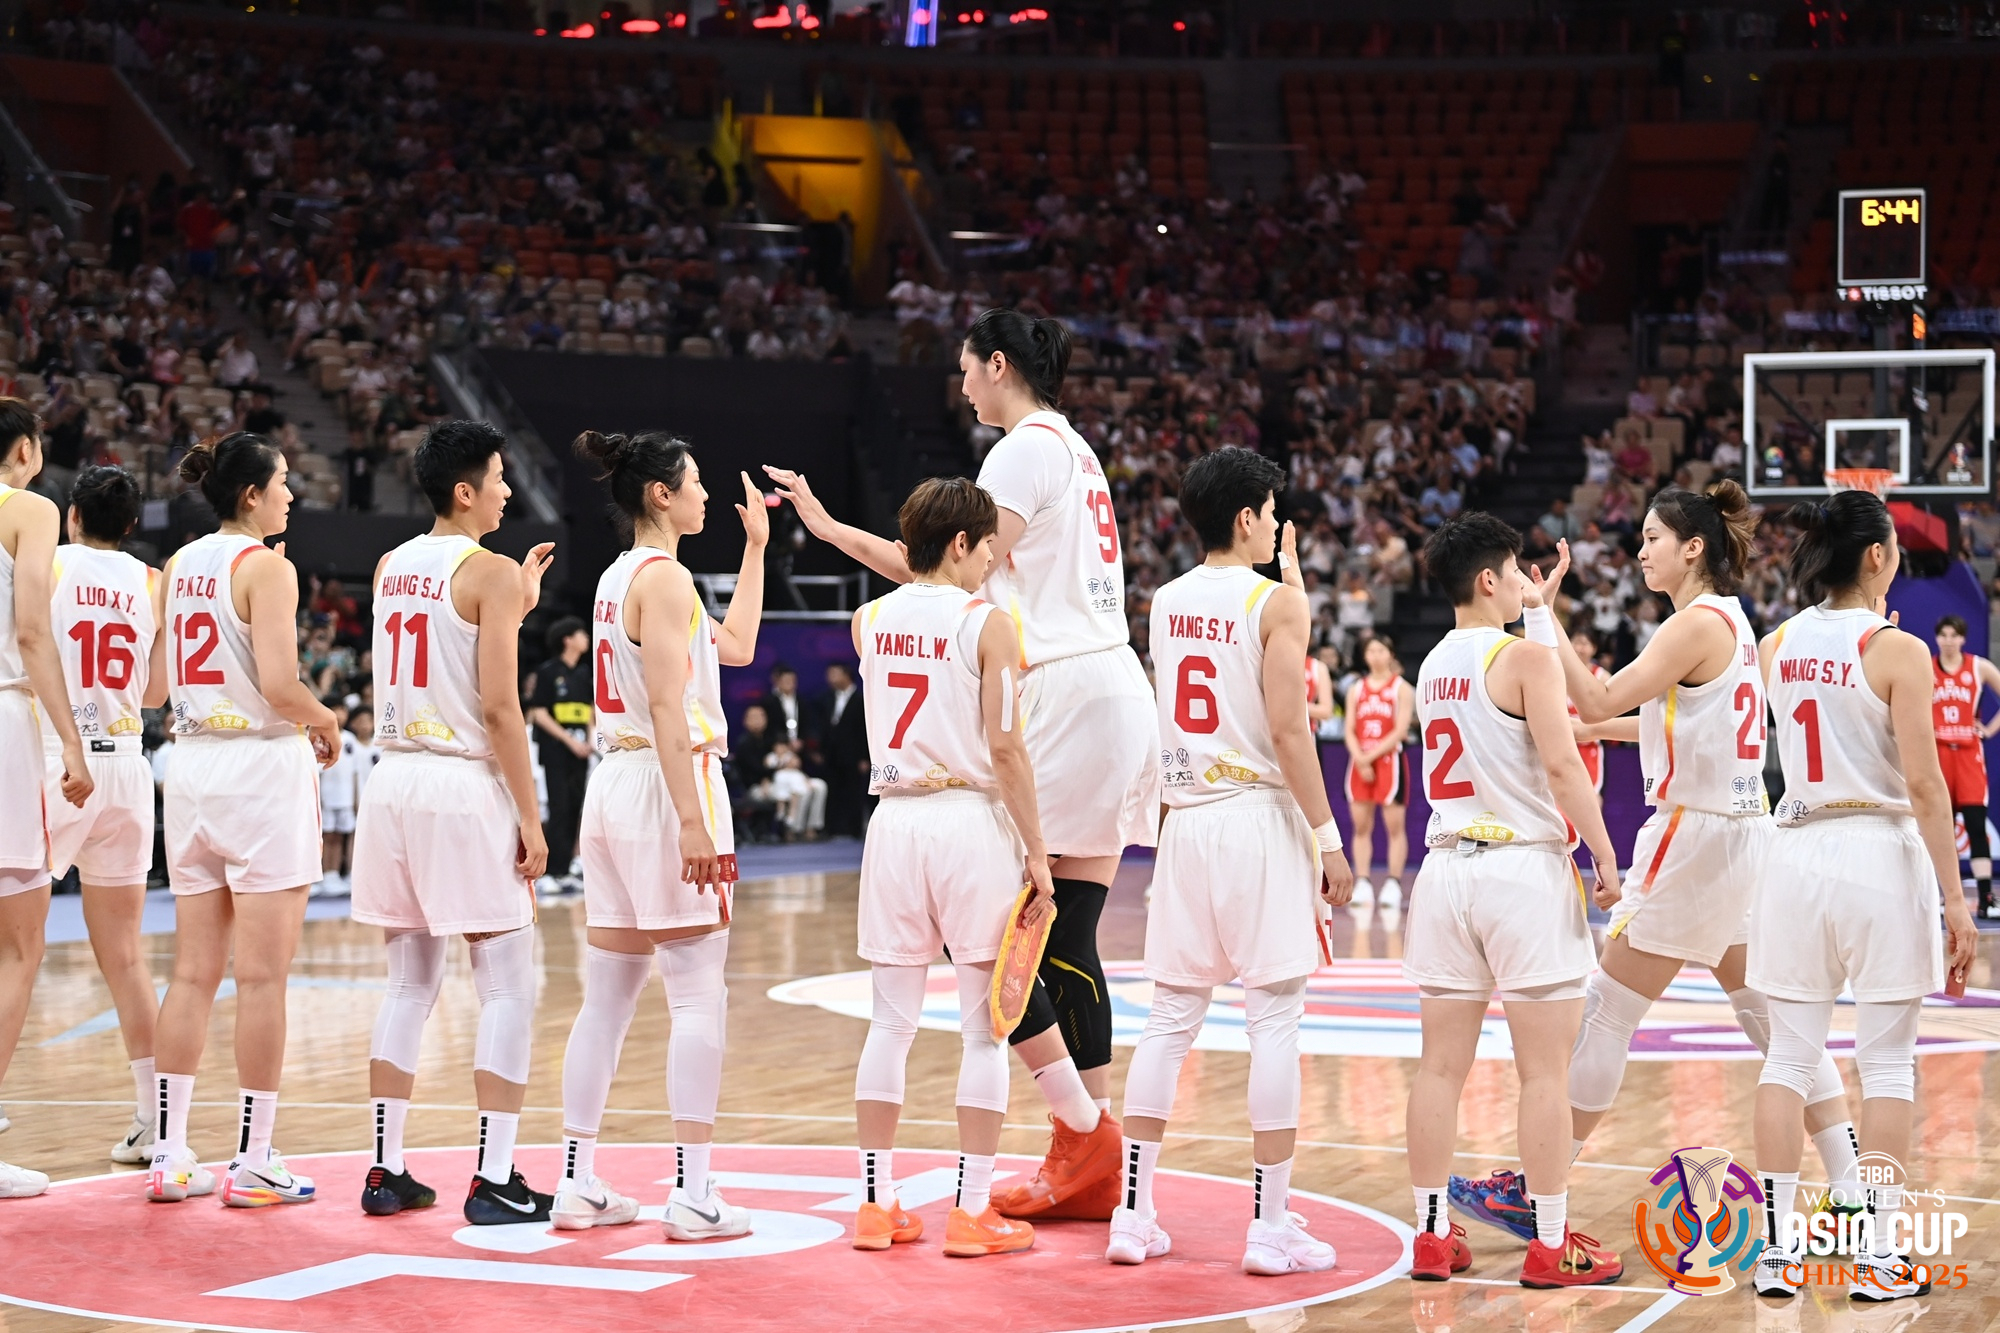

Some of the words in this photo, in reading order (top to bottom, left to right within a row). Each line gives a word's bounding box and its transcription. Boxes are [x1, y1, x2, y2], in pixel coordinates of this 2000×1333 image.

[1861, 199, 1919, 226] 6:44
[1861, 285, 1928, 301] TISSOT
[76, 585, 107, 607] LUO
[382, 574, 419, 598] HUANG
[1169, 614, 1203, 639] YANG
[1206, 618, 1237, 645] S.Y.
[68, 620, 138, 690] 16
[173, 612, 225, 687] 12
[384, 607, 429, 688] 11
[875, 632, 914, 657] YANG
[918, 635, 951, 661] L.W.
[1780, 658, 1818, 683] WANG
[1821, 660, 1856, 688] S.Y.
[1174, 655, 1220, 734] 6
[887, 672, 929, 749] 7
[1942, 705, 1960, 724] 10
[1792, 699, 1824, 783] 1
[1425, 718, 1475, 800] 2
